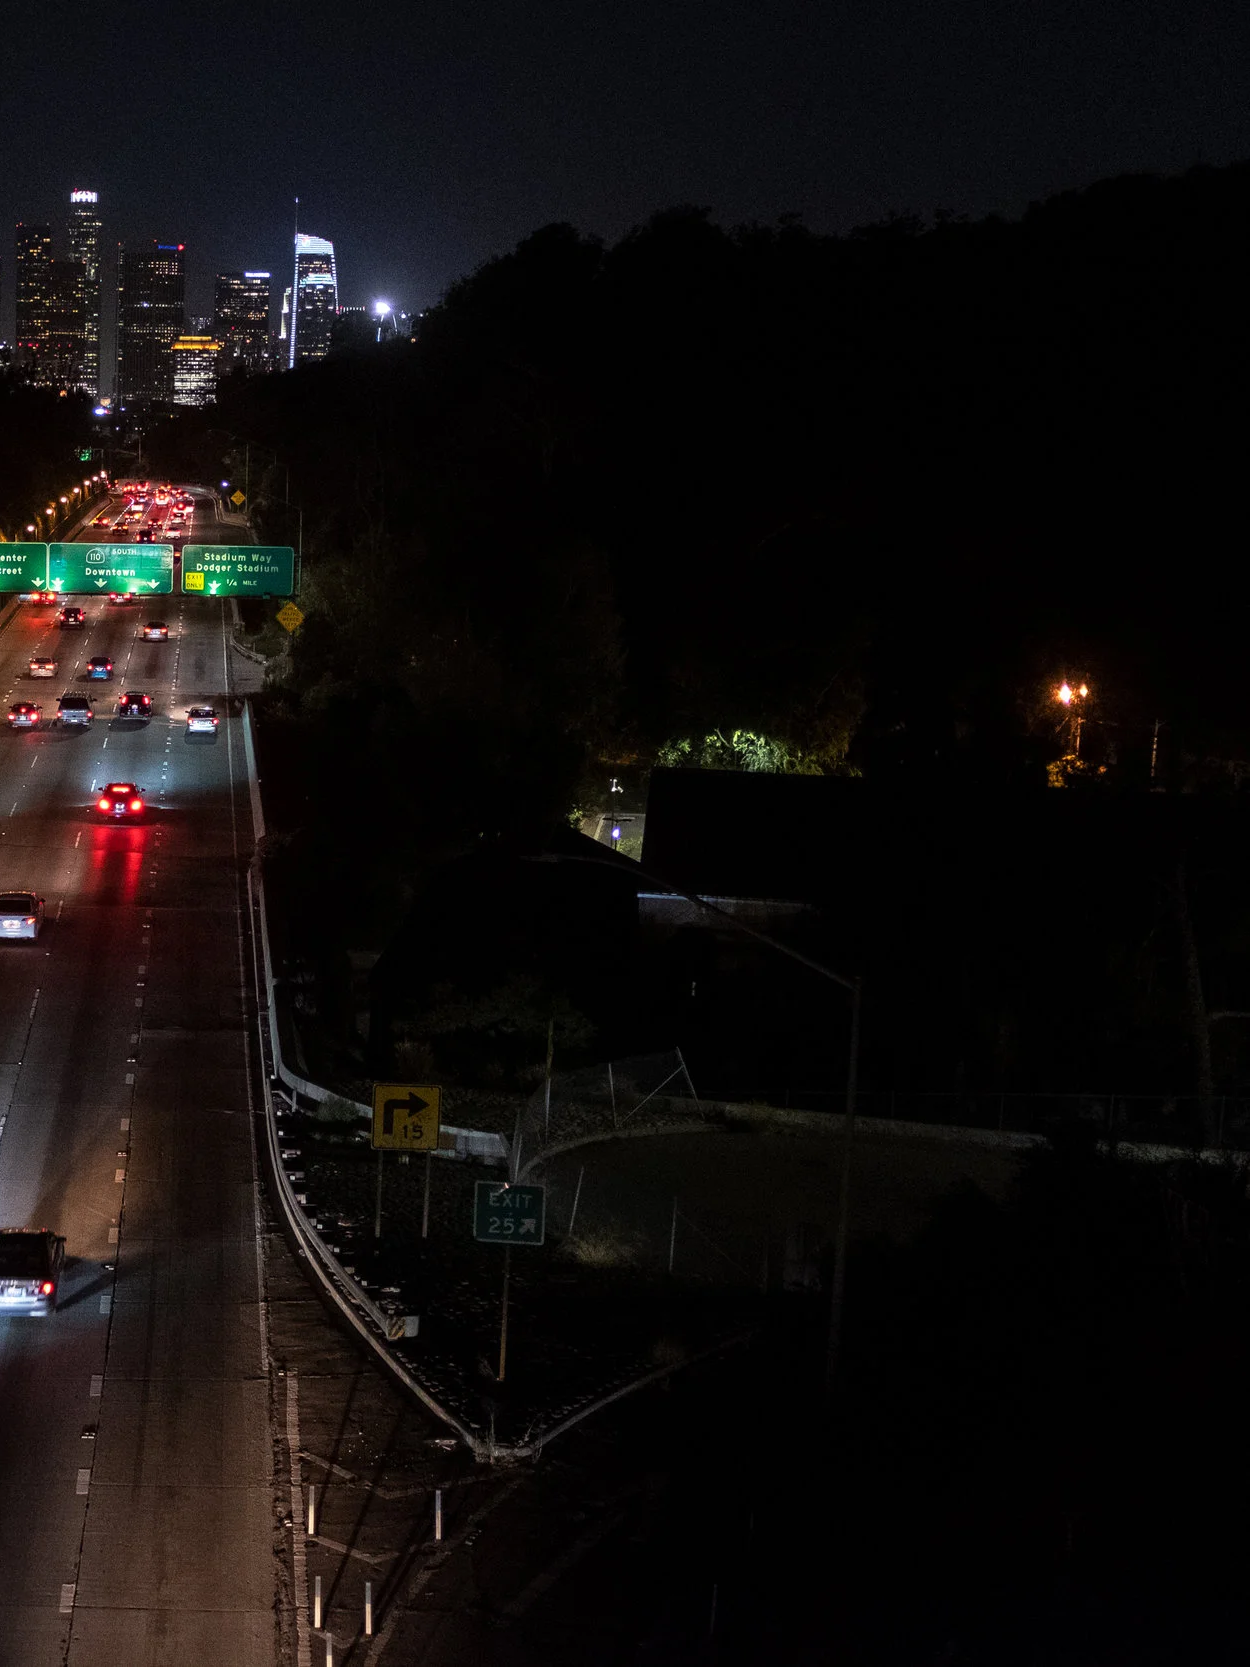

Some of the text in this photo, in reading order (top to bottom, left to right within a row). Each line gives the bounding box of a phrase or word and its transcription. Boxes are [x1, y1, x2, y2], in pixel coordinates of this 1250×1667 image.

[90, 553, 101, 561] 110
[204, 552, 272, 564] Stadium Way
[85, 568, 136, 576] Downtown
[196, 563, 279, 573] Dodger Stadium
[403, 1125, 423, 1139] 15
[489, 1191, 533, 1209] EXIT
[488, 1216, 515, 1235] 25
